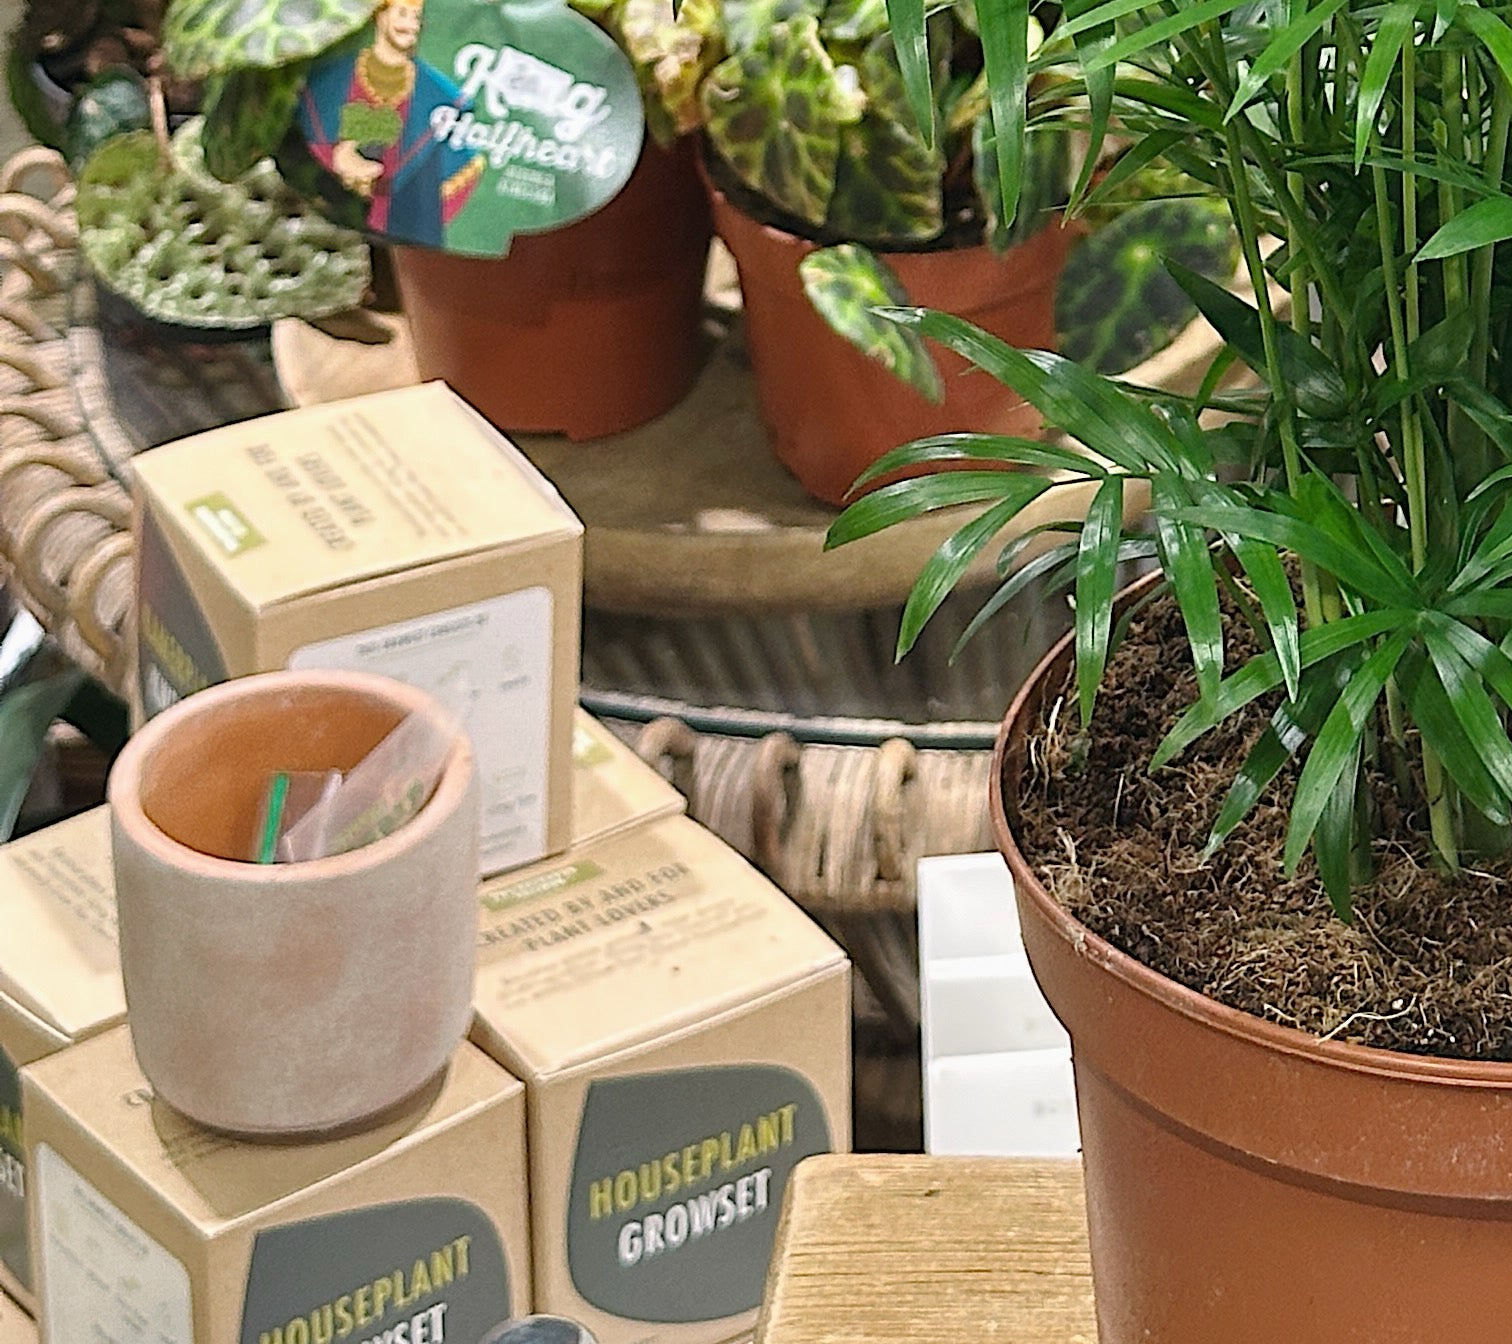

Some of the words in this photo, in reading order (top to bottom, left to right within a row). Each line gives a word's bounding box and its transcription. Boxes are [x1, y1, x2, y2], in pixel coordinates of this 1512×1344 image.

[454, 43, 611, 141] Kg
[430, 105, 616, 178] Halfheart
[478, 909, 561, 946] REATED
[599, 878, 646, 904] AND
[589, 1102, 797, 1219] HOUSEPLANT
[617, 1167, 772, 1267] GROWSET
